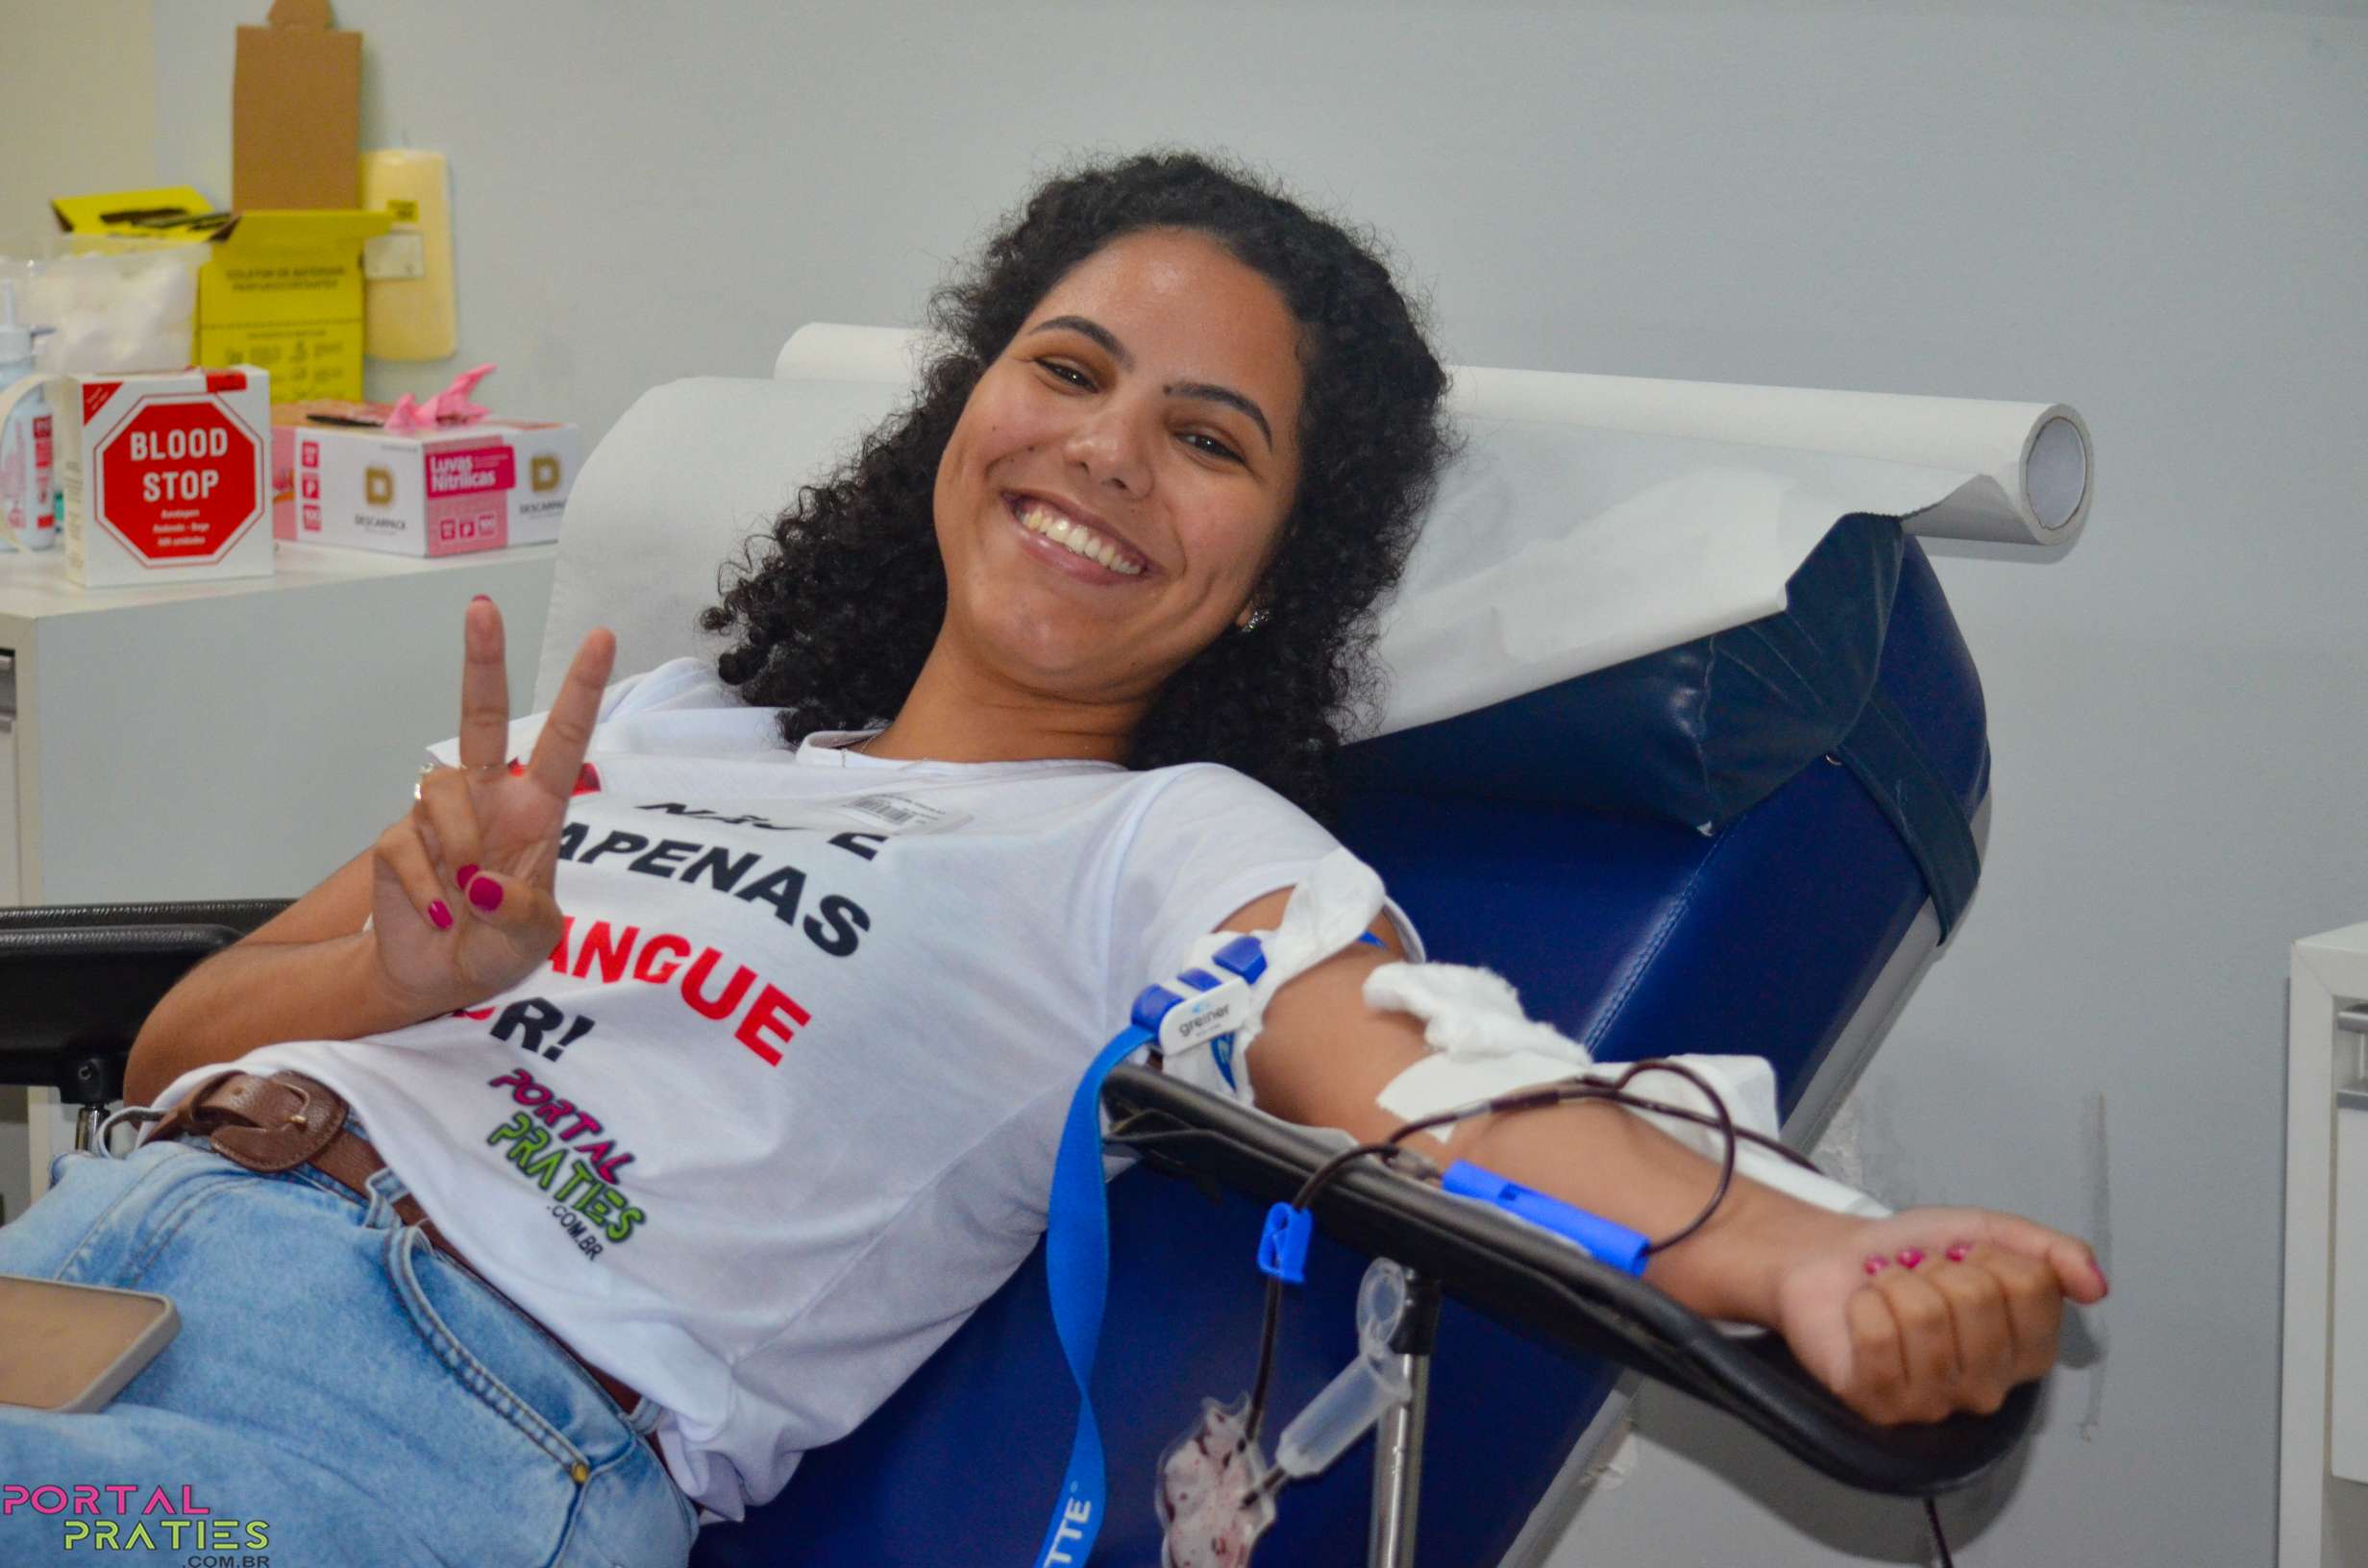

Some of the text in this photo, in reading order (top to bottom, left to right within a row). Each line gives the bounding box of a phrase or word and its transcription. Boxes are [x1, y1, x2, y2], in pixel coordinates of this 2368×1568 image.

[130, 428, 229, 461] BLOOD
[431, 454, 473, 474] Luvas
[142, 469, 220, 502] STOP
[558, 821, 871, 957] APENAS
[547, 915, 813, 1067] ANGUE
[1178, 1004, 1230, 1038] greiner
[487, 1067, 636, 1186] PORTAL
[485, 1111, 647, 1243] PRATIES
[546, 1204, 604, 1262] .COM.BR
